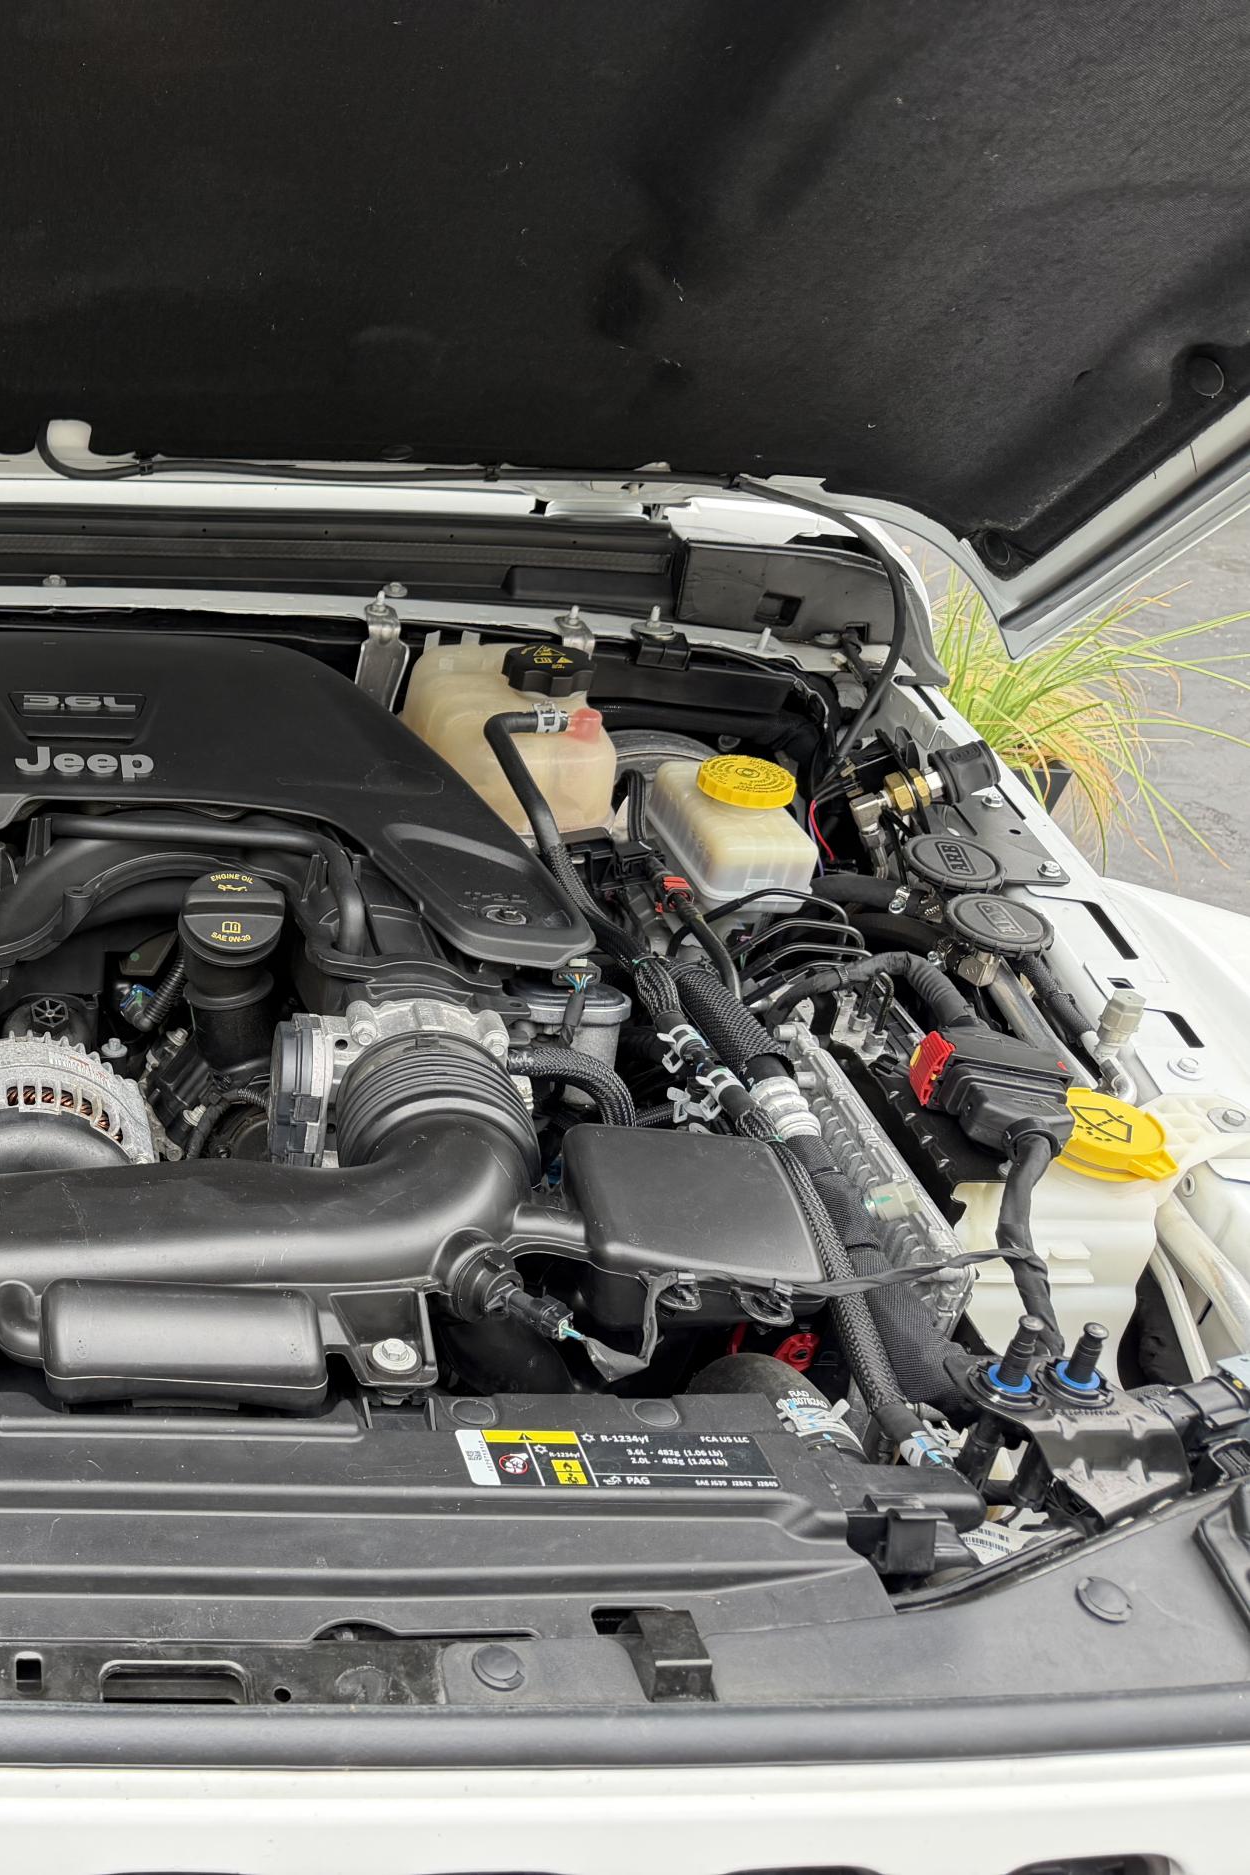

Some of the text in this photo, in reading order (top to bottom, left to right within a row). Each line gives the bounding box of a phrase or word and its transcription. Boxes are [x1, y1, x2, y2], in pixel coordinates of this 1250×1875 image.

[23, 695, 136, 712] 3.6L
[15, 746, 154, 782] Jeep
[941, 844, 970, 873] ARB
[210, 873, 254, 884] ENGINE OIL
[211, 931, 251, 942] SAE 0W-20
[600, 1435, 649, 1444] R-1234yf
[549, 1451, 580, 1459] R-1234yf
[657, 1449, 681, 1457] 482g
[708, 1449, 723, 1457] Lb)
[661, 1458, 685, 1466] 482g
[713, 1459, 728, 1467] Lb)
[626, 1476, 650, 1484] PAG
